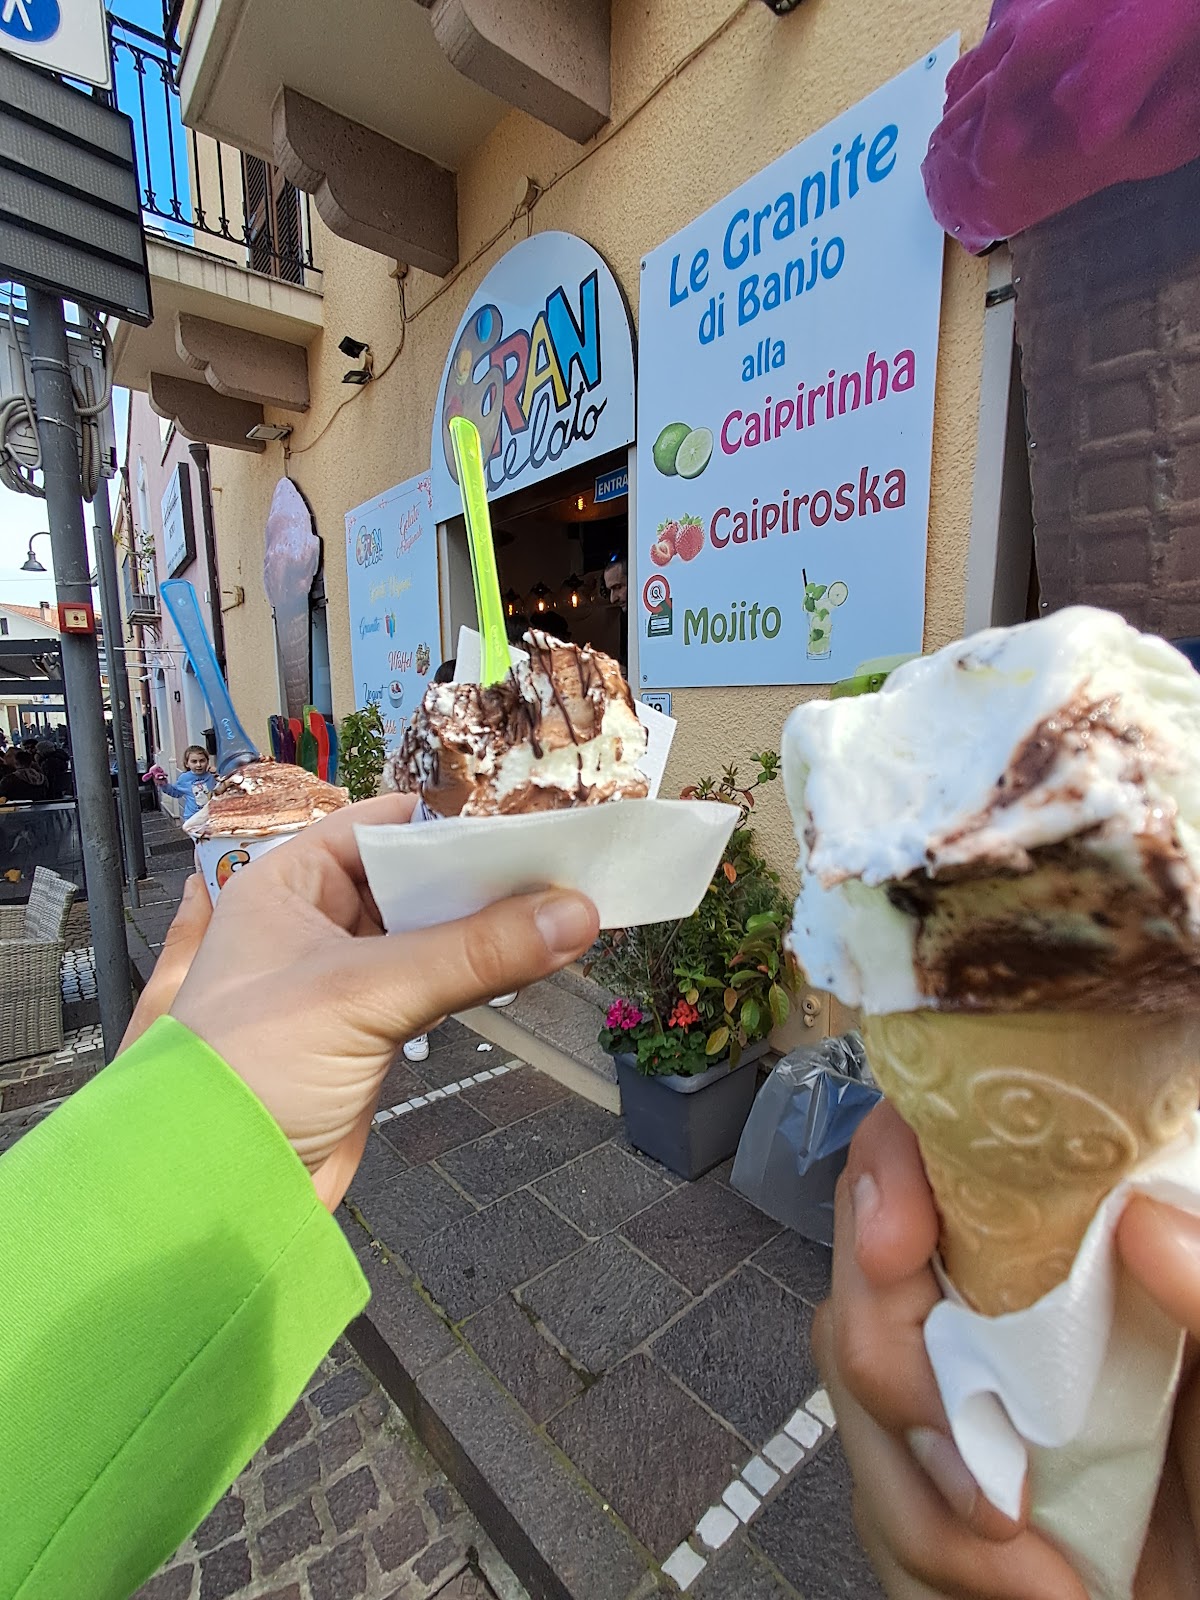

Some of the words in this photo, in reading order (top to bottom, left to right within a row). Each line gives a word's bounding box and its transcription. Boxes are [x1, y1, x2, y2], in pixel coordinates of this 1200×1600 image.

[668, 247, 710, 307] Le
[722, 124, 899, 270] Granite
[698, 292, 725, 345] di
[738, 236, 846, 326] Banjo
[719, 348, 917, 456] Caipirinha
[741, 337, 786, 382] alla
[709, 466, 907, 550] Caipiroska
[683, 600, 783, 646] Mojito
